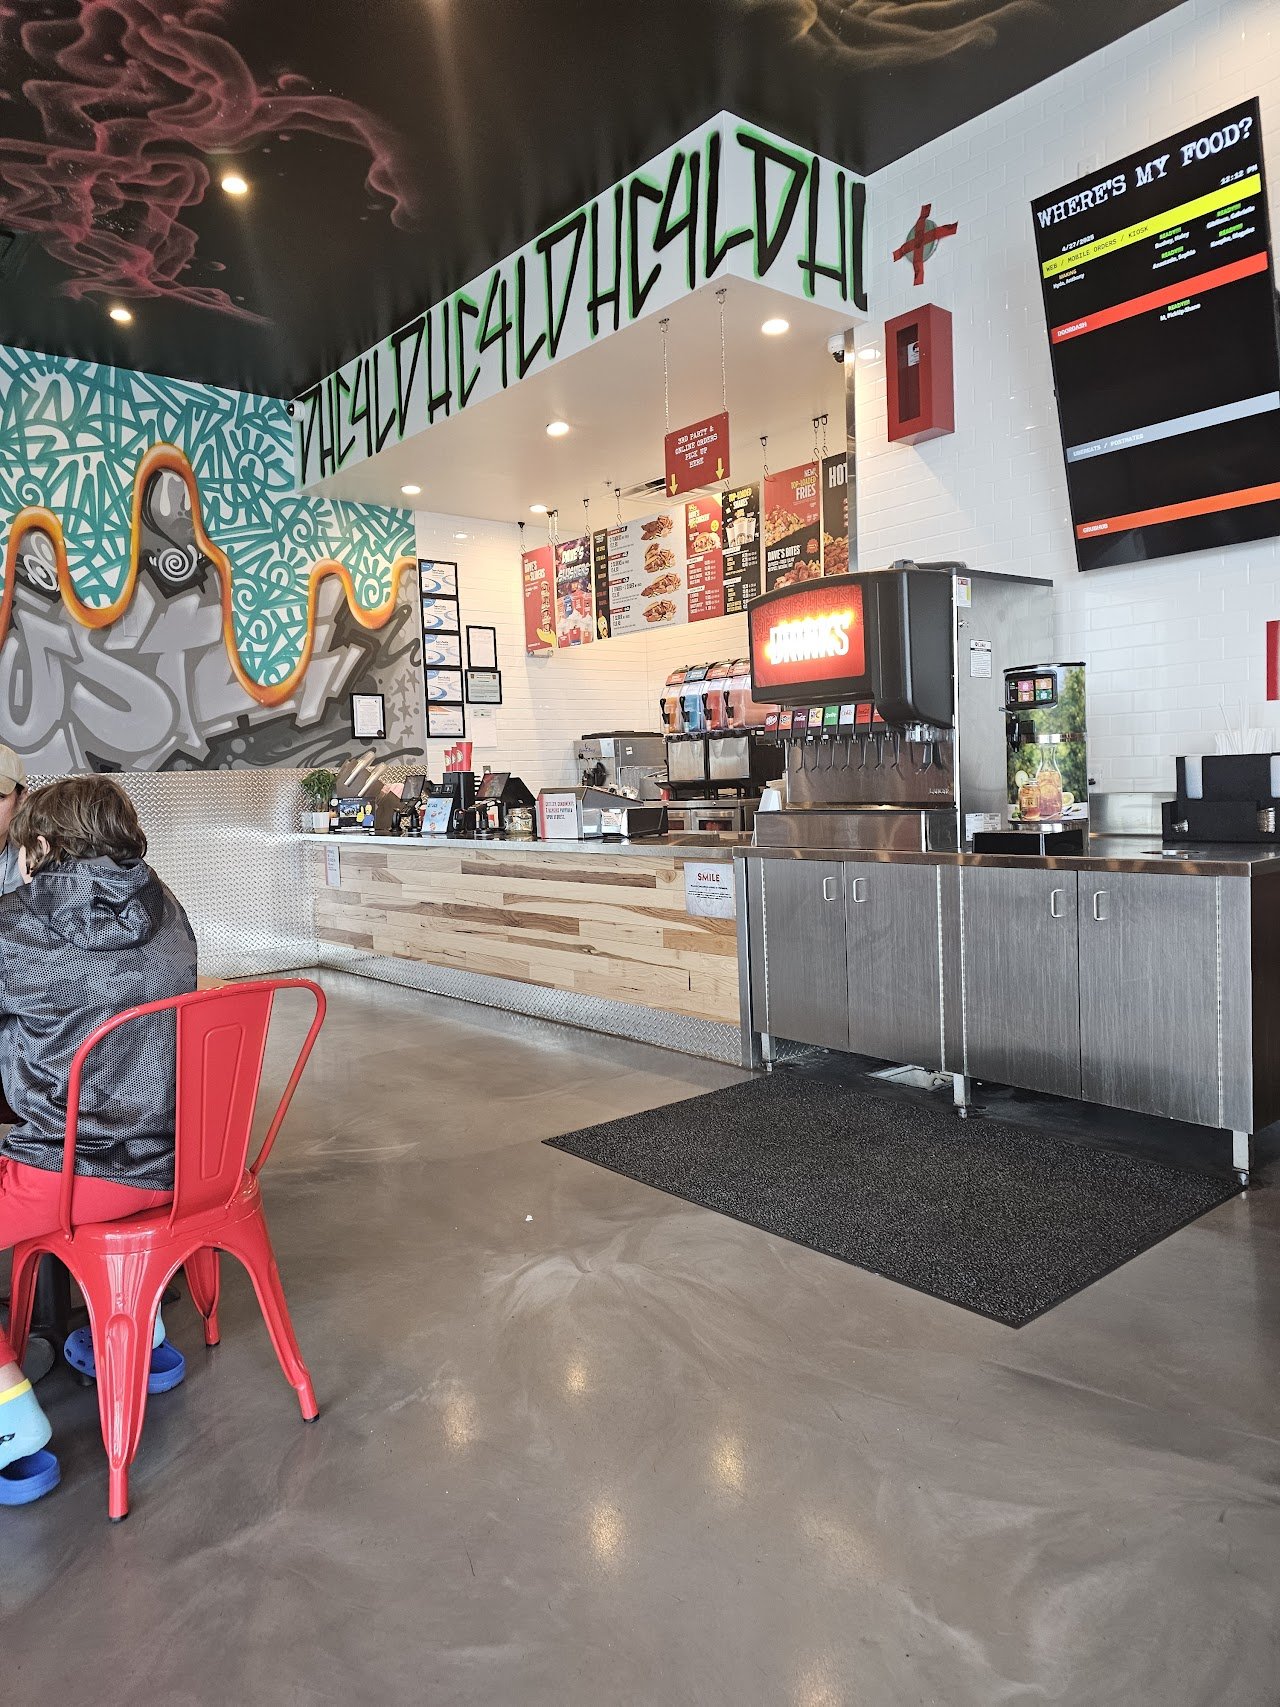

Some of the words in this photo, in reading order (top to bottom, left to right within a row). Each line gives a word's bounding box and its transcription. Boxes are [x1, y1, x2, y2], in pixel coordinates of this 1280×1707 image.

[1037, 174, 1127, 229] WHERE'S
[1135, 154, 1170, 188] MY
[1180, 116, 1253, 167] FOOD?
[1046, 262, 1058, 273] WEB
[1067, 249, 1090, 264] MOBILE
[1093, 238, 1117, 253] ORDERS
[1128, 226, 1149, 239] KIOSK
[1057, 321, 1088, 338] DOORDASH
[675, 441, 696, 455] ONLINE
[696, 433, 718, 447] ORDERS
[677, 435, 689, 445] 3RD
[690, 427, 708, 441] PARTY
[1073, 444, 1102, 457] UBEREATS
[1110, 433, 1144, 447] POSTMATES
[685, 450, 698, 461] PICK
[700, 446, 708, 455] UP
[689, 457, 704, 468] HERE
[795, 483, 816, 501] FRIES
[1083, 523, 1108, 534] GRUBHUB
[767, 547, 785, 562] DAVE'S
[786, 544, 801, 559] BITES
[769, 611, 851, 666] DRINKS
[697, 872, 720, 882] SMILE
